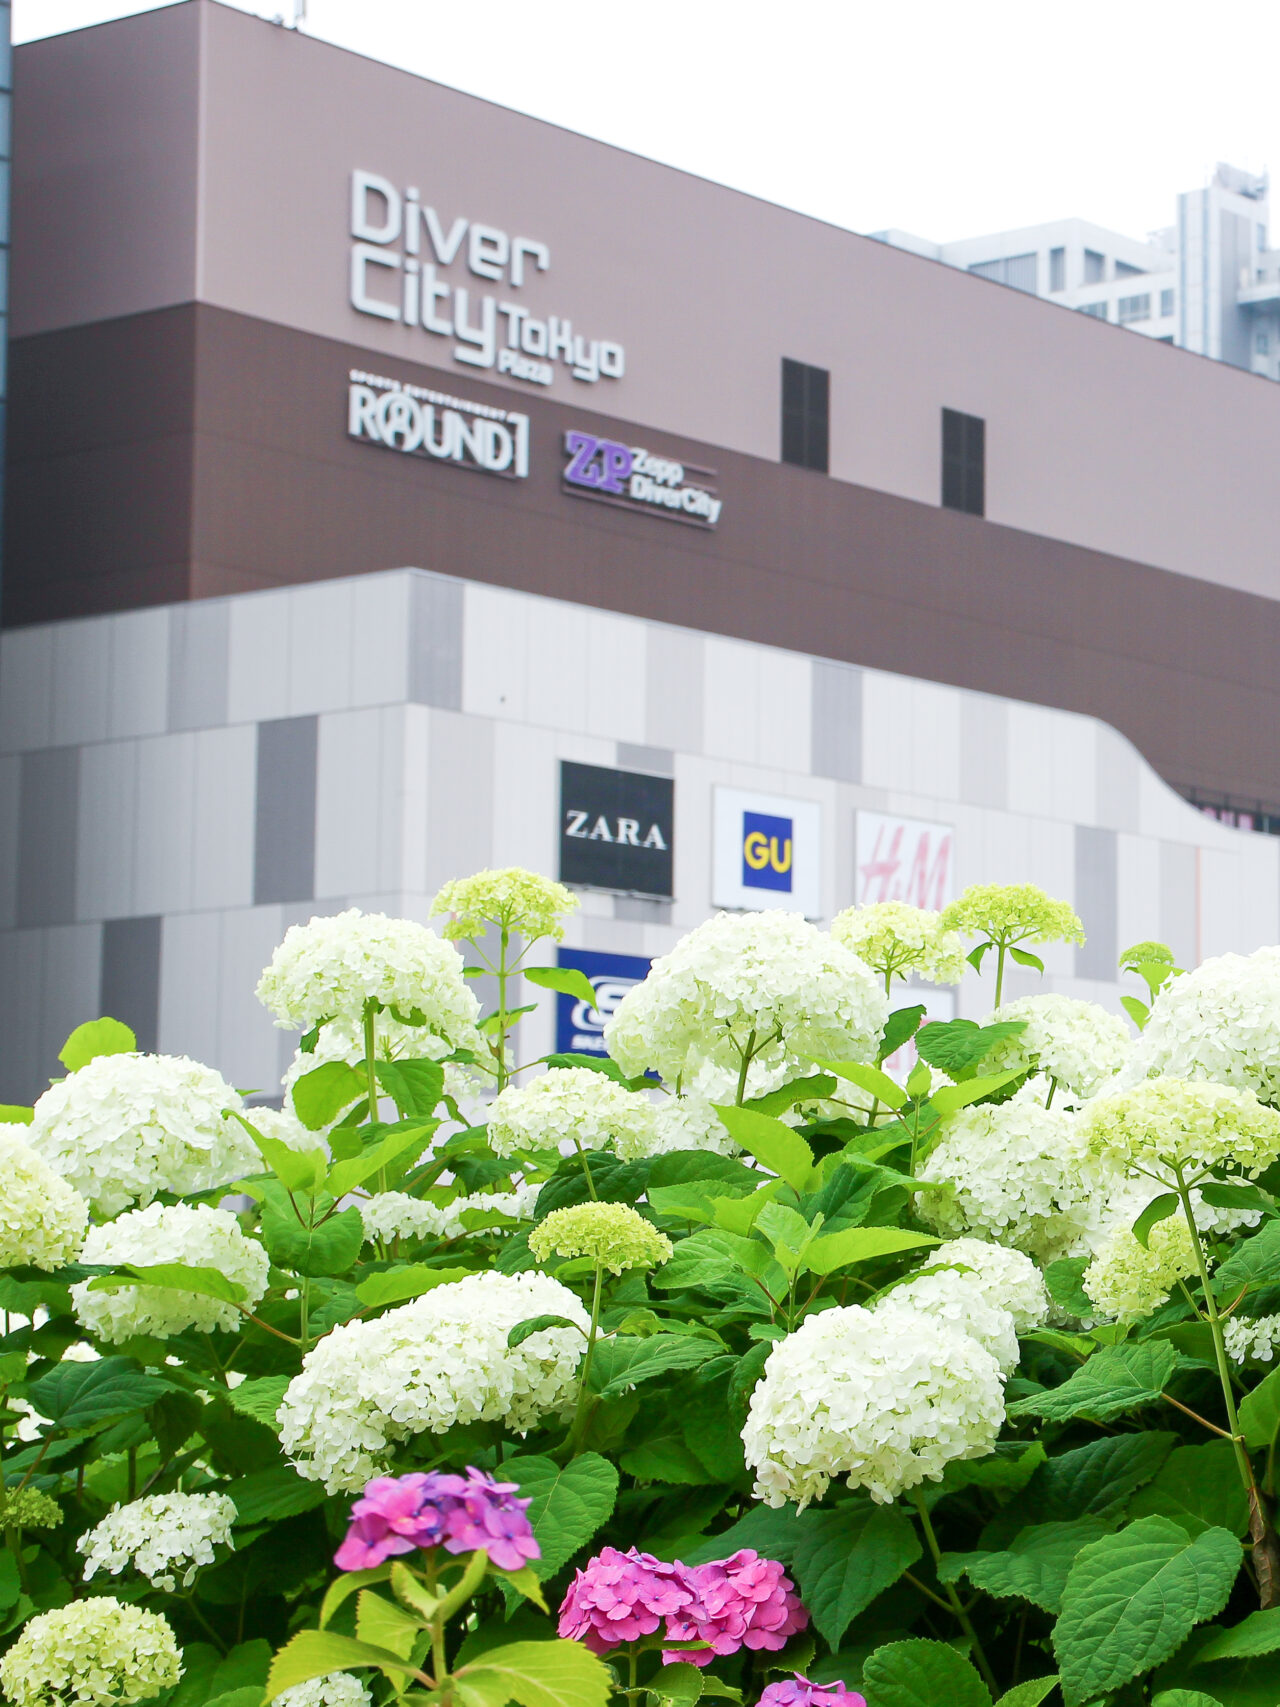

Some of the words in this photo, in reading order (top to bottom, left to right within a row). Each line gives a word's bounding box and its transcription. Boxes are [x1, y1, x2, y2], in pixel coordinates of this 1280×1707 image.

[351, 169, 549, 287] Diver
[351, 243, 494, 368] City
[497, 350, 553, 385] Plaza
[564, 429, 633, 494] ZP
[565, 809, 668, 851] ZARA
[743, 831, 792, 874] GU
